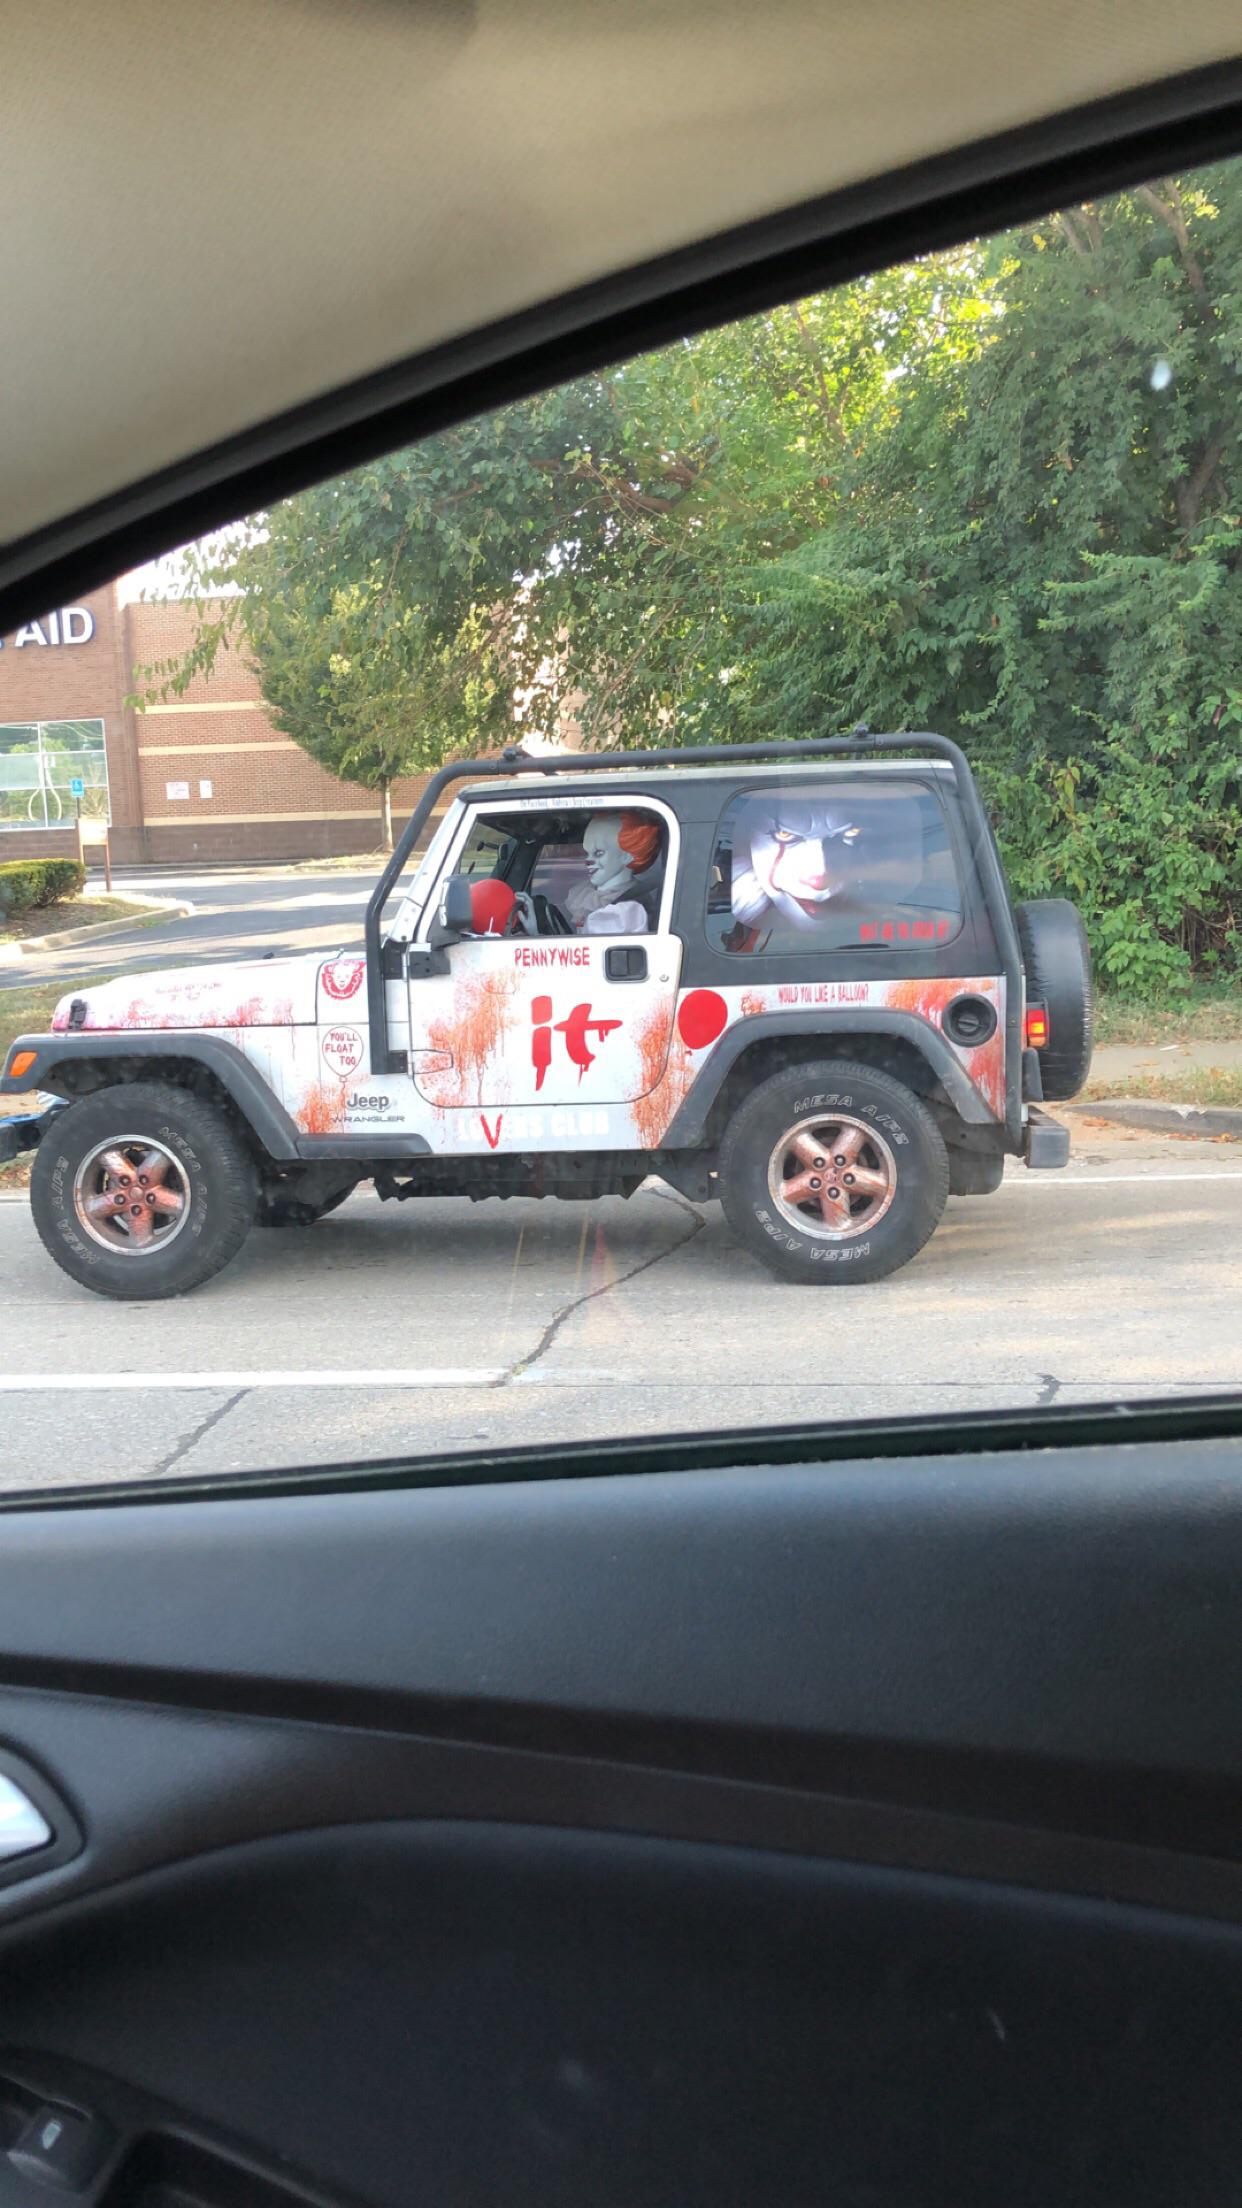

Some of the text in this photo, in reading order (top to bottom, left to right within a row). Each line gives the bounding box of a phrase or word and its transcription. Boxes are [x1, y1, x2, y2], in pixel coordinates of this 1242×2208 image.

[13, 606, 96, 648] AID
[514, 947, 591, 969] PENNYWISE
[778, 986, 799, 1004] WOULD
[801, 986, 812, 1003] YOU
[815, 985, 828, 1003] LIKE
[831, 985, 836, 1001] A
[330, 1032, 358, 1042] YOU'LL
[531, 995, 623, 1092] it
[325, 1043, 354, 1054] FLOAT
[339, 1056, 356, 1066] TOO
[346, 1093, 391, 1112] Jeep
[794, 1094, 852, 1113] MESA
[810, 1242, 871, 1261] MESA
